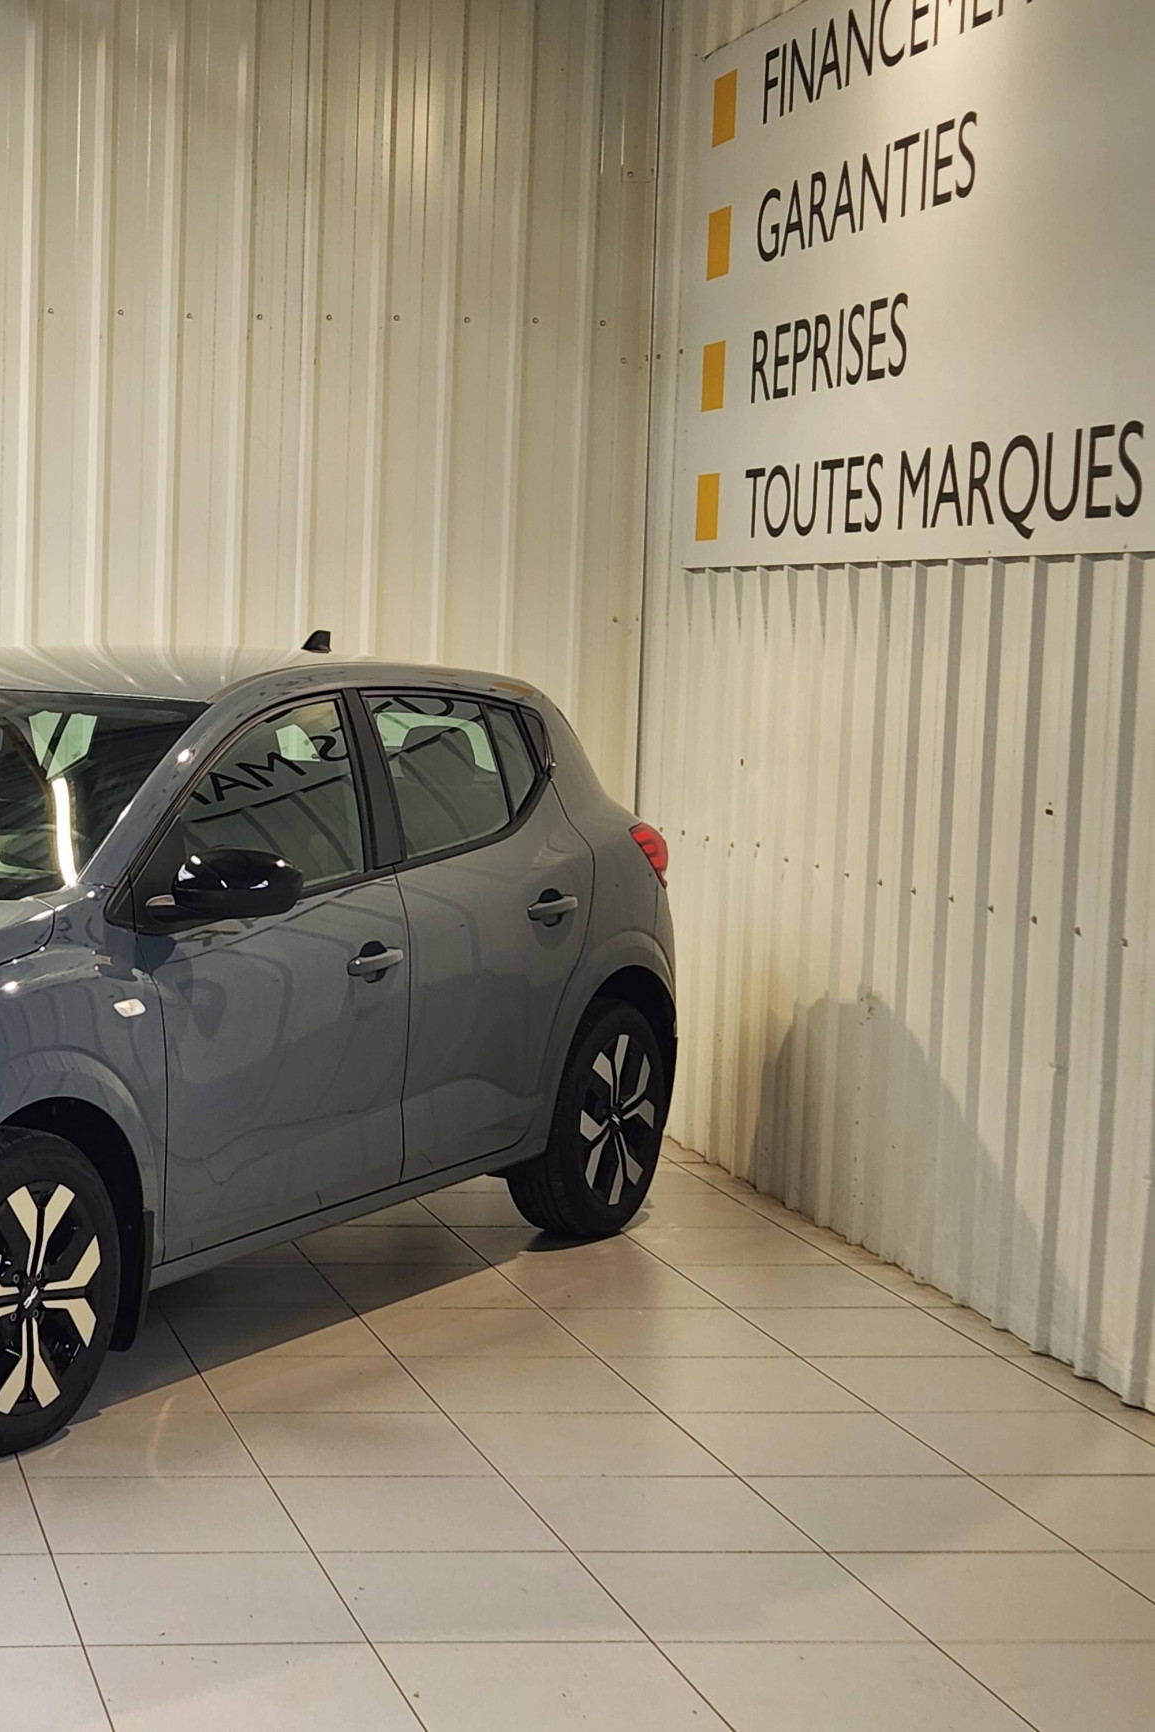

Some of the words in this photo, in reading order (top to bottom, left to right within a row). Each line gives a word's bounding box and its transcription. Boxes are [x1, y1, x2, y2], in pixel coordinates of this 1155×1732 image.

[762, 0, 1033, 124] FINANCE
[757, 111, 977, 262] GARANTIES
[750, 292, 908, 403] REPRISES
[745, 453, 883, 538] TOUTES
[897, 420, 1144, 539] MARQUES
